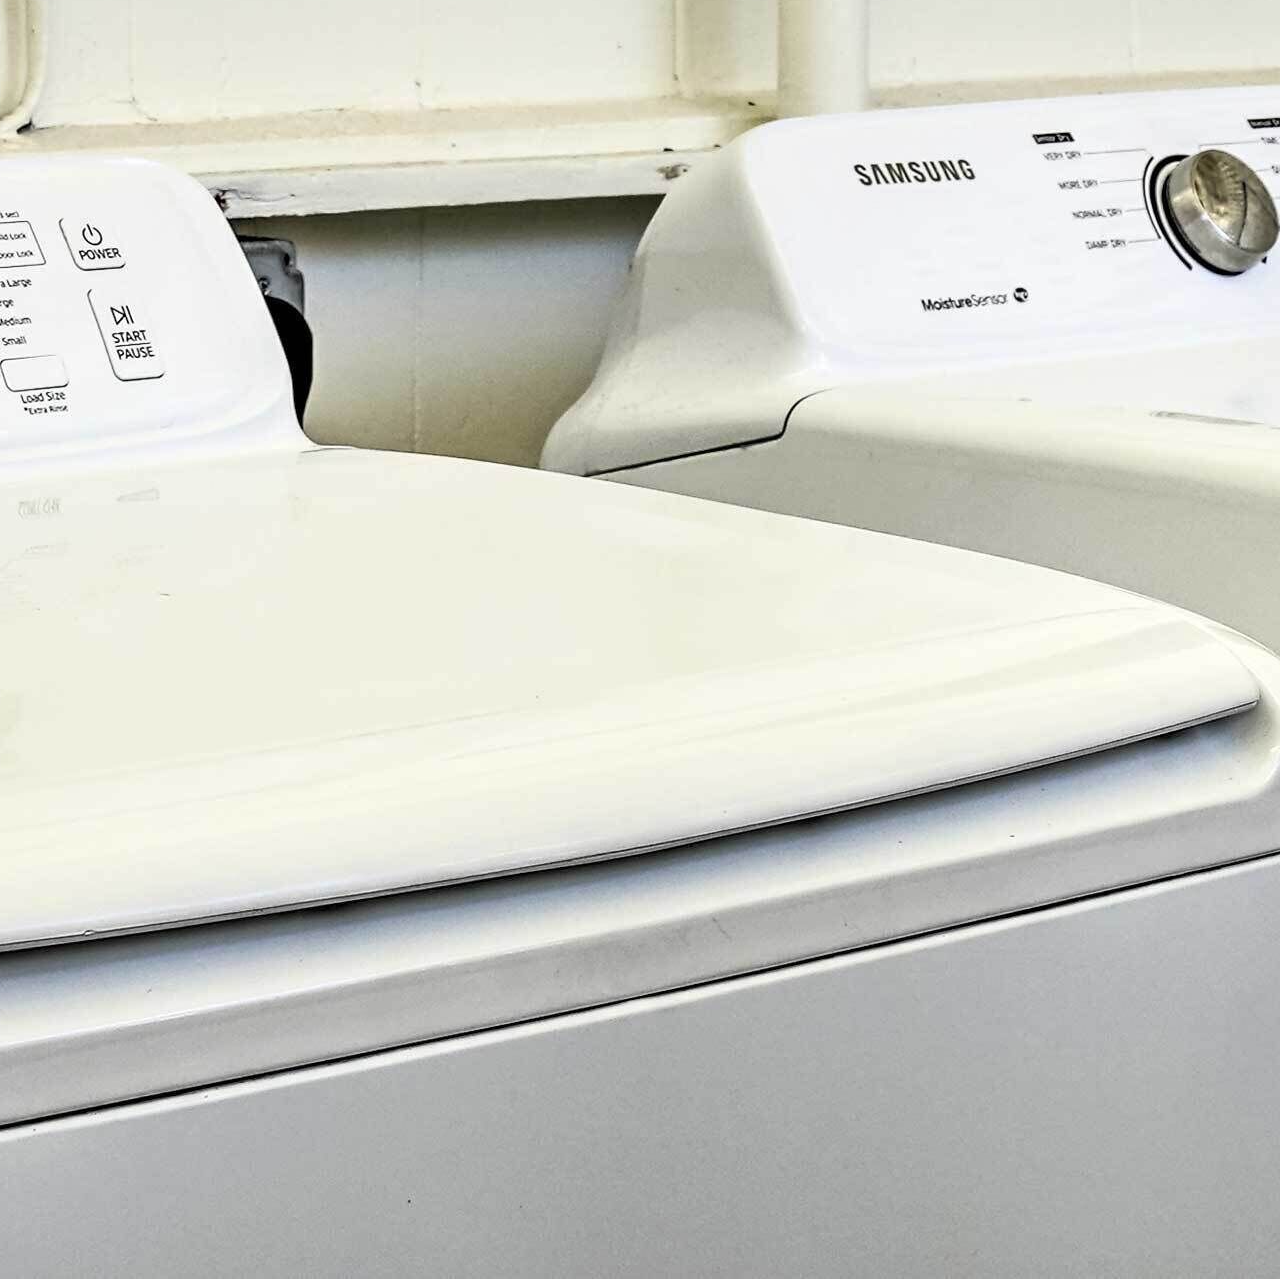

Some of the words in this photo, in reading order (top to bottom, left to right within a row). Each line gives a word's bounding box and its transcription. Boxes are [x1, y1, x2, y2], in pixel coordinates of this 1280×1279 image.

[1043, 152, 1063, 161] VERY
[1065, 151, 1081, 159] DRY
[854, 159, 976, 186] SAMSUNG
[1058, 180, 1081, 189] MORE
[1082, 179, 1098, 188] DRY
[1072, 210, 1106, 219] NORMAL
[1107, 208, 1122, 217] DRY
[10, 233, 27, 241] Lock
[1085, 240, 1109, 250] DAMP
[1110, 239, 1126, 248] DRY
[17, 250, 34, 258] Lock
[79, 248, 122, 260] POWER
[7, 277, 32, 288] Large
[921, 293, 1007, 311] MoistureSensor
[1, 335, 27, 346] Small
[112, 329, 147, 343] START
[116, 346, 155, 360] PAUSE
[20, 392, 44, 404] Load
[45, 391, 66, 402] Size
